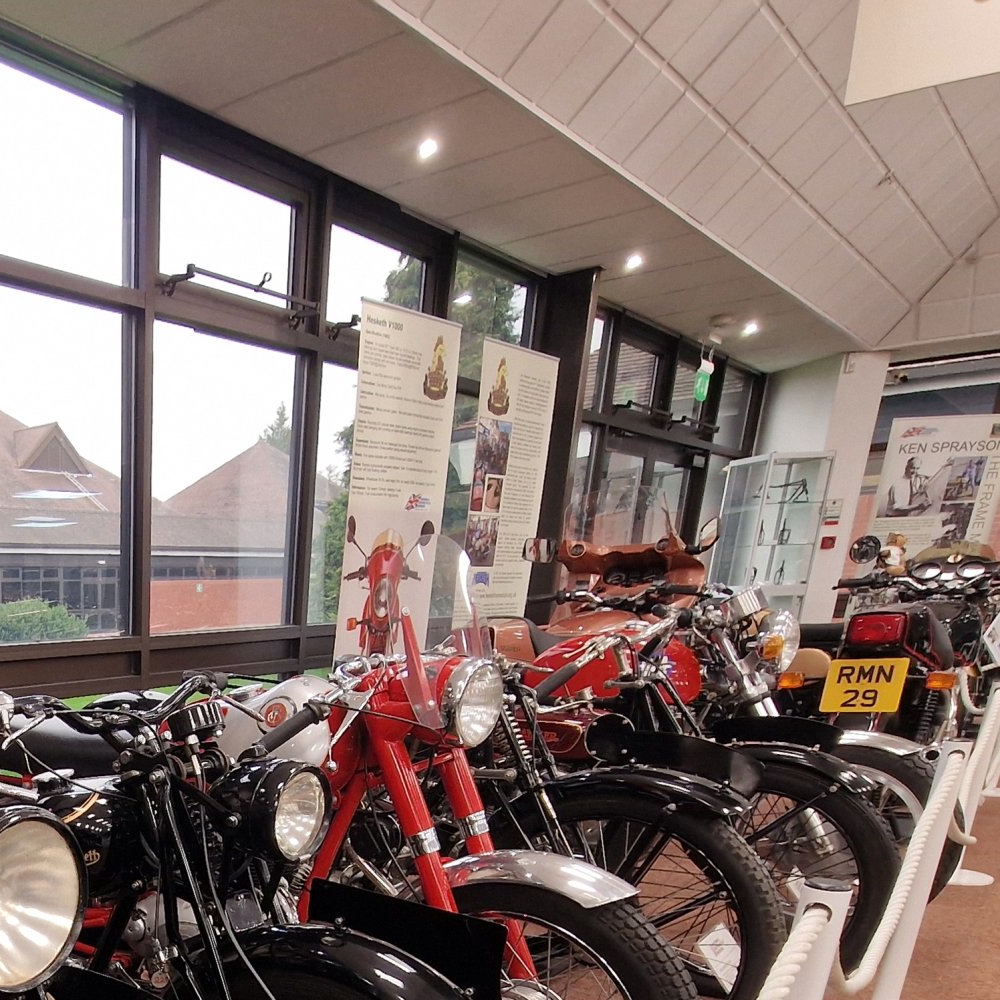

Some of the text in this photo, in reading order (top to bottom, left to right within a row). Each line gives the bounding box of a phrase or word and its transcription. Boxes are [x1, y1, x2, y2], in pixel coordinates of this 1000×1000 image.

[898, 442, 927, 455] KEN
[975, 484, 993, 529] FRAME
[836, 665, 896, 684] RMN
[840, 689, 879, 708] 29
